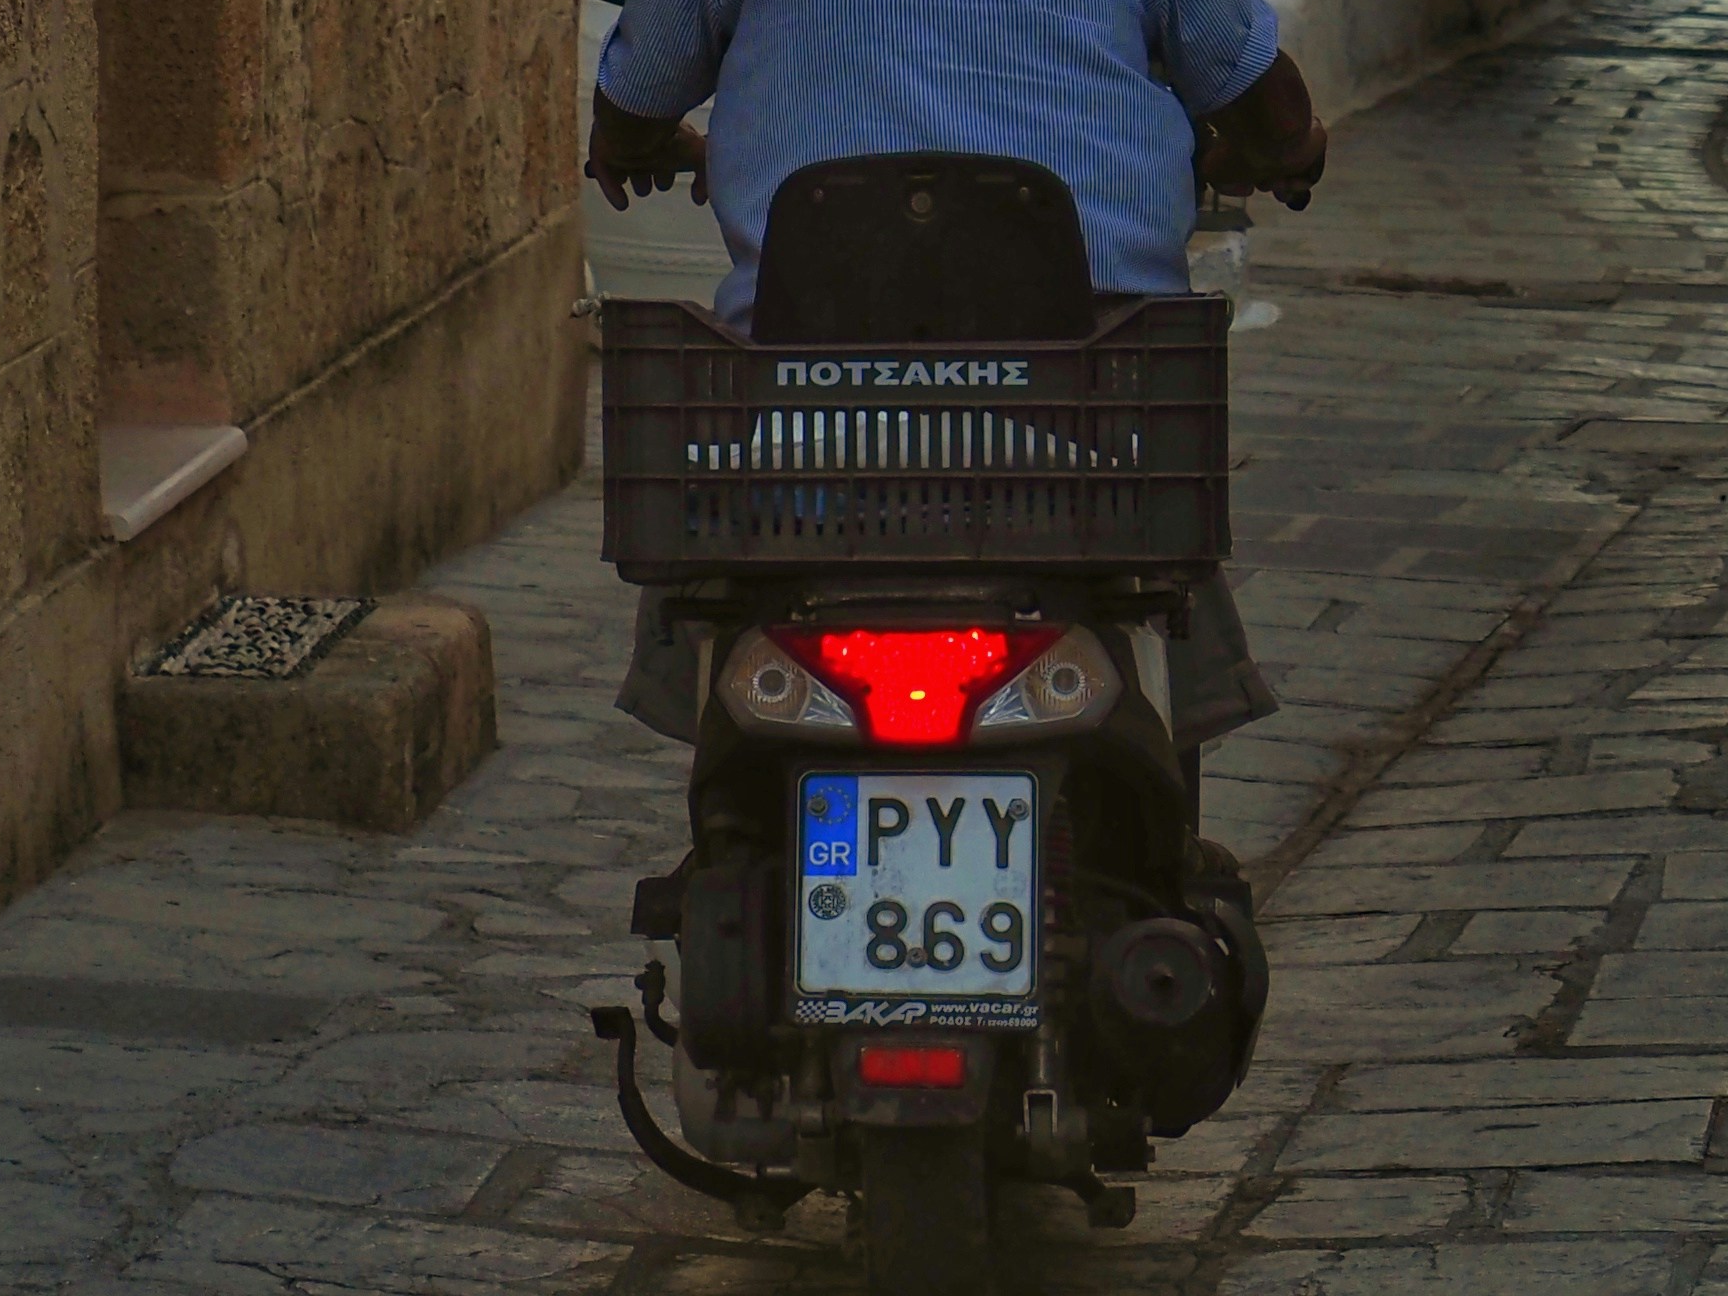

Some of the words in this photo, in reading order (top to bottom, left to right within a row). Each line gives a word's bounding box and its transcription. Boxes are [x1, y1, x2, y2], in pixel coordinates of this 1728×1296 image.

[776, 361, 1029, 386] ΠΟΤΣΑΚΗΣ
[867, 797, 1021, 869] PYY
[808, 841, 851, 866] GR
[866, 901, 1023, 973] 869
[931, 1002, 1039, 1017] www.vacar.gr
